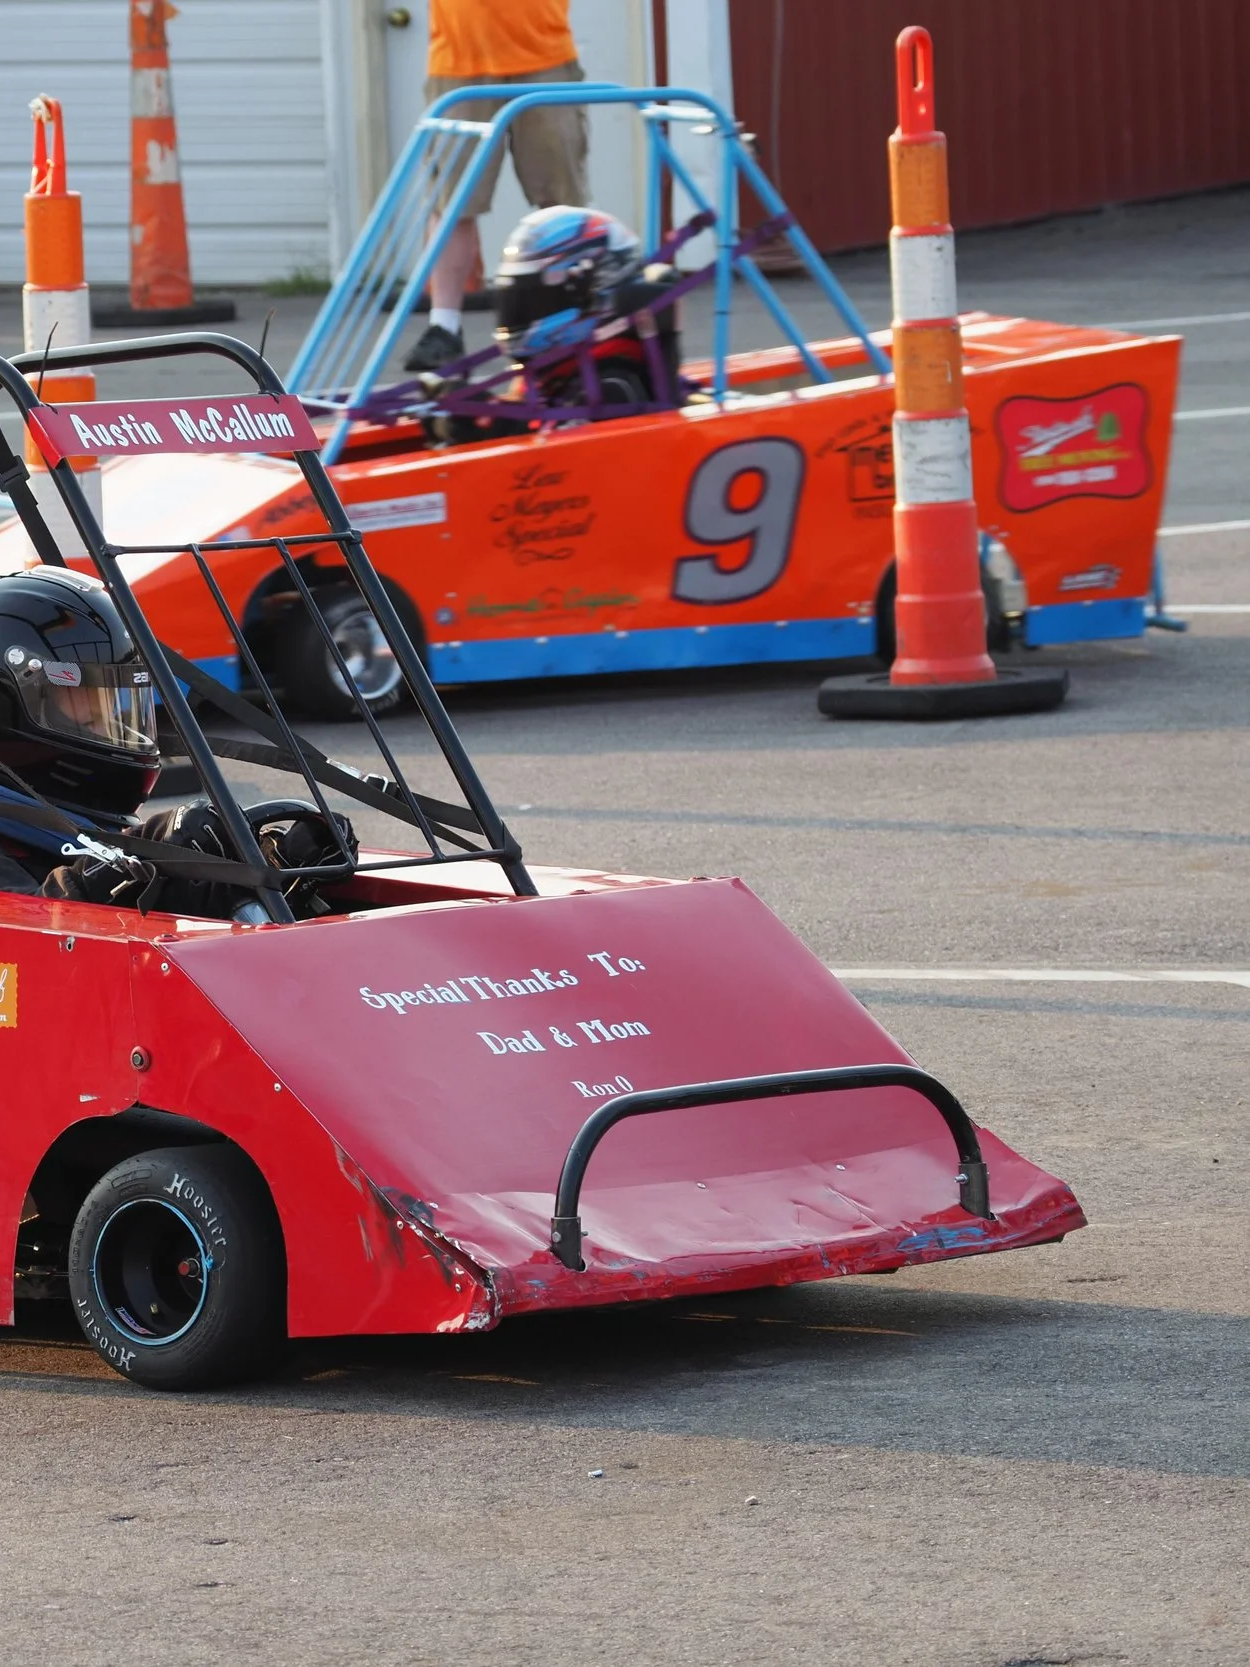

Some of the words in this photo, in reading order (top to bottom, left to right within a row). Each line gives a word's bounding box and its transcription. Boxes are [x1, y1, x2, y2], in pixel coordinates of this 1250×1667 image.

[69, 413, 163, 449] Austin
[169, 403, 295, 445] McCallum
[671, 436, 807, 605] 9
[359, 980, 471, 1015] Special
[458, 968, 580, 1000] Thanks
[587, 950, 647, 977] To:
[476, 1030, 547, 1055] Dad
[548, 1025, 579, 1048] &
[576, 1019, 651, 1044] Mom
[571, 1080, 619, 1098] Ron
[163, 1172, 227, 1247] Hoosier
[77, 1298, 137, 1372] Hoosier
